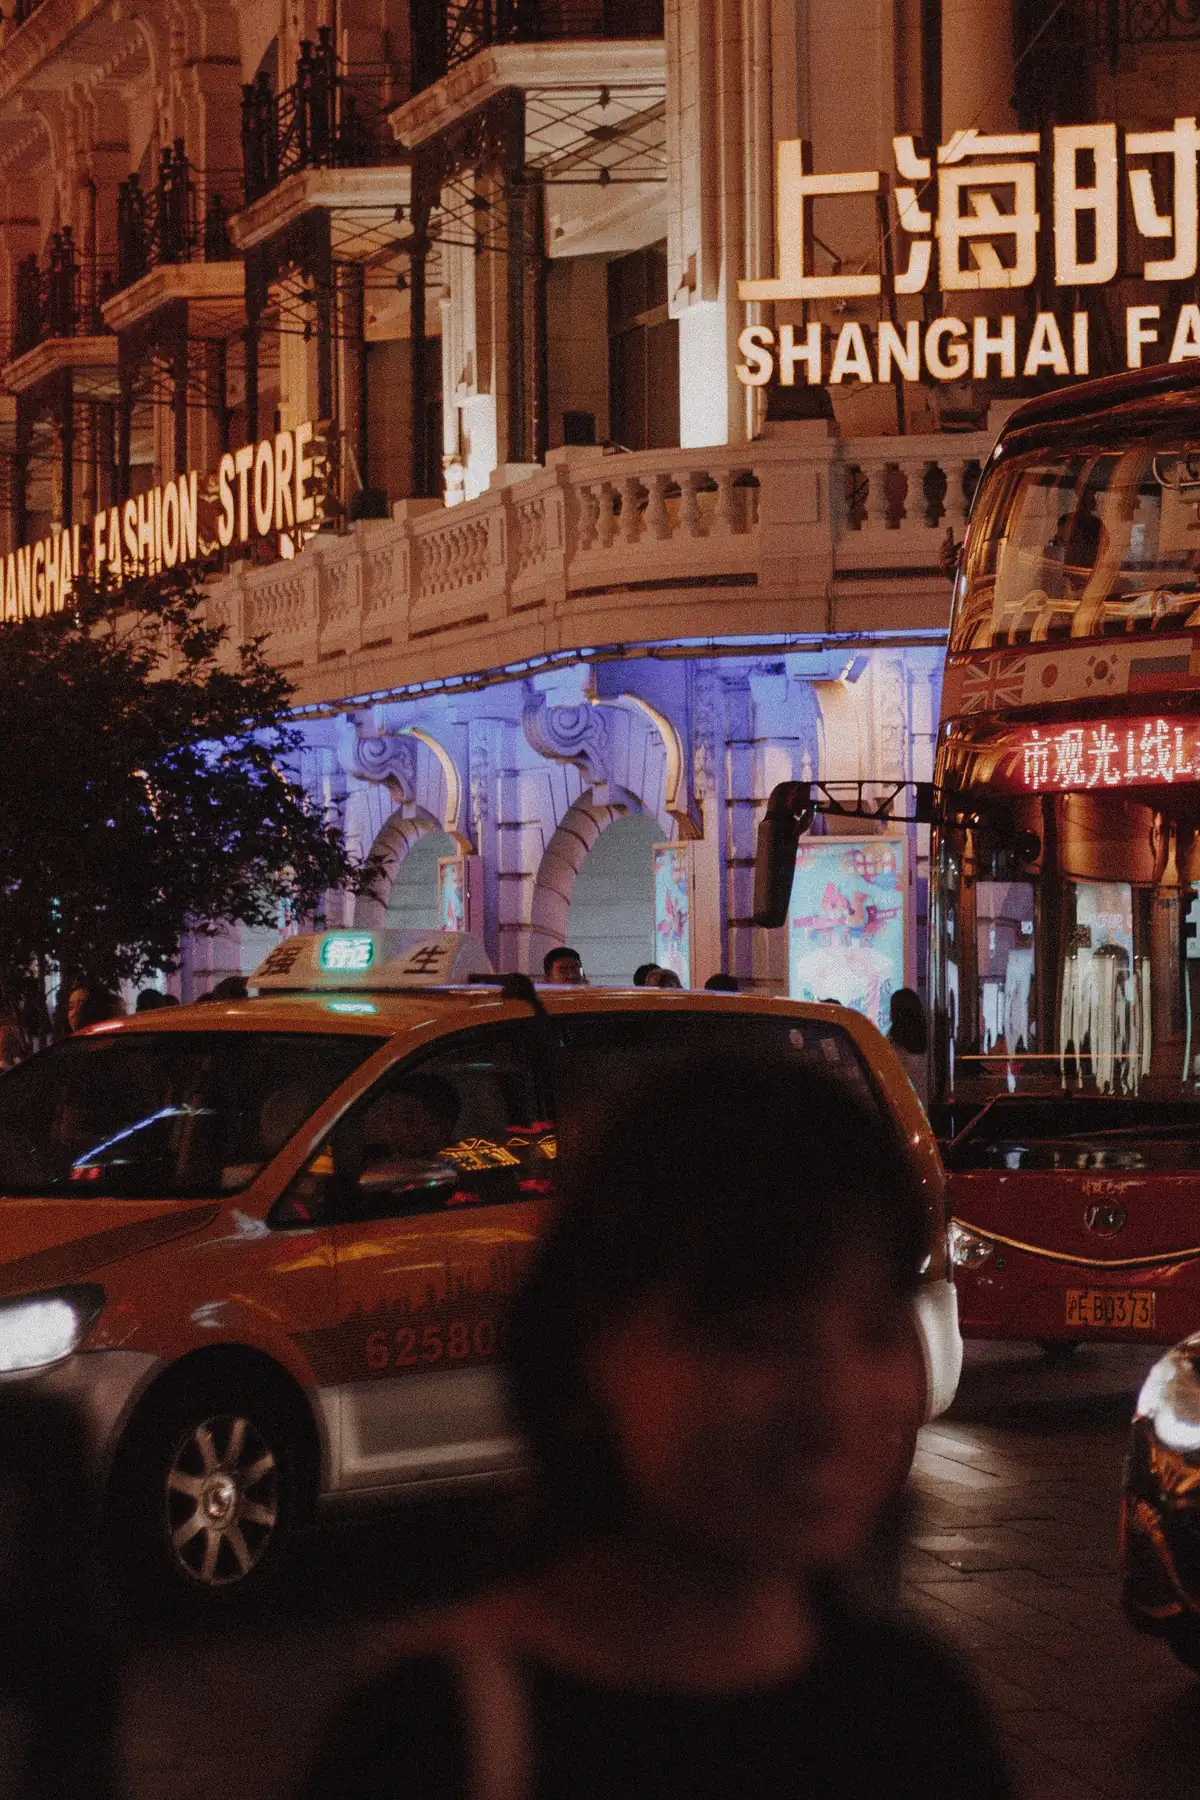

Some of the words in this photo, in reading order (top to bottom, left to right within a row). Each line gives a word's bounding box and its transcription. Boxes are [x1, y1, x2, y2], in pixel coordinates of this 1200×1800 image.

[738, 309, 1089, 387] SHANGHAI
[94, 470, 198, 588] FASHION
[218, 421, 314, 547] STORE
